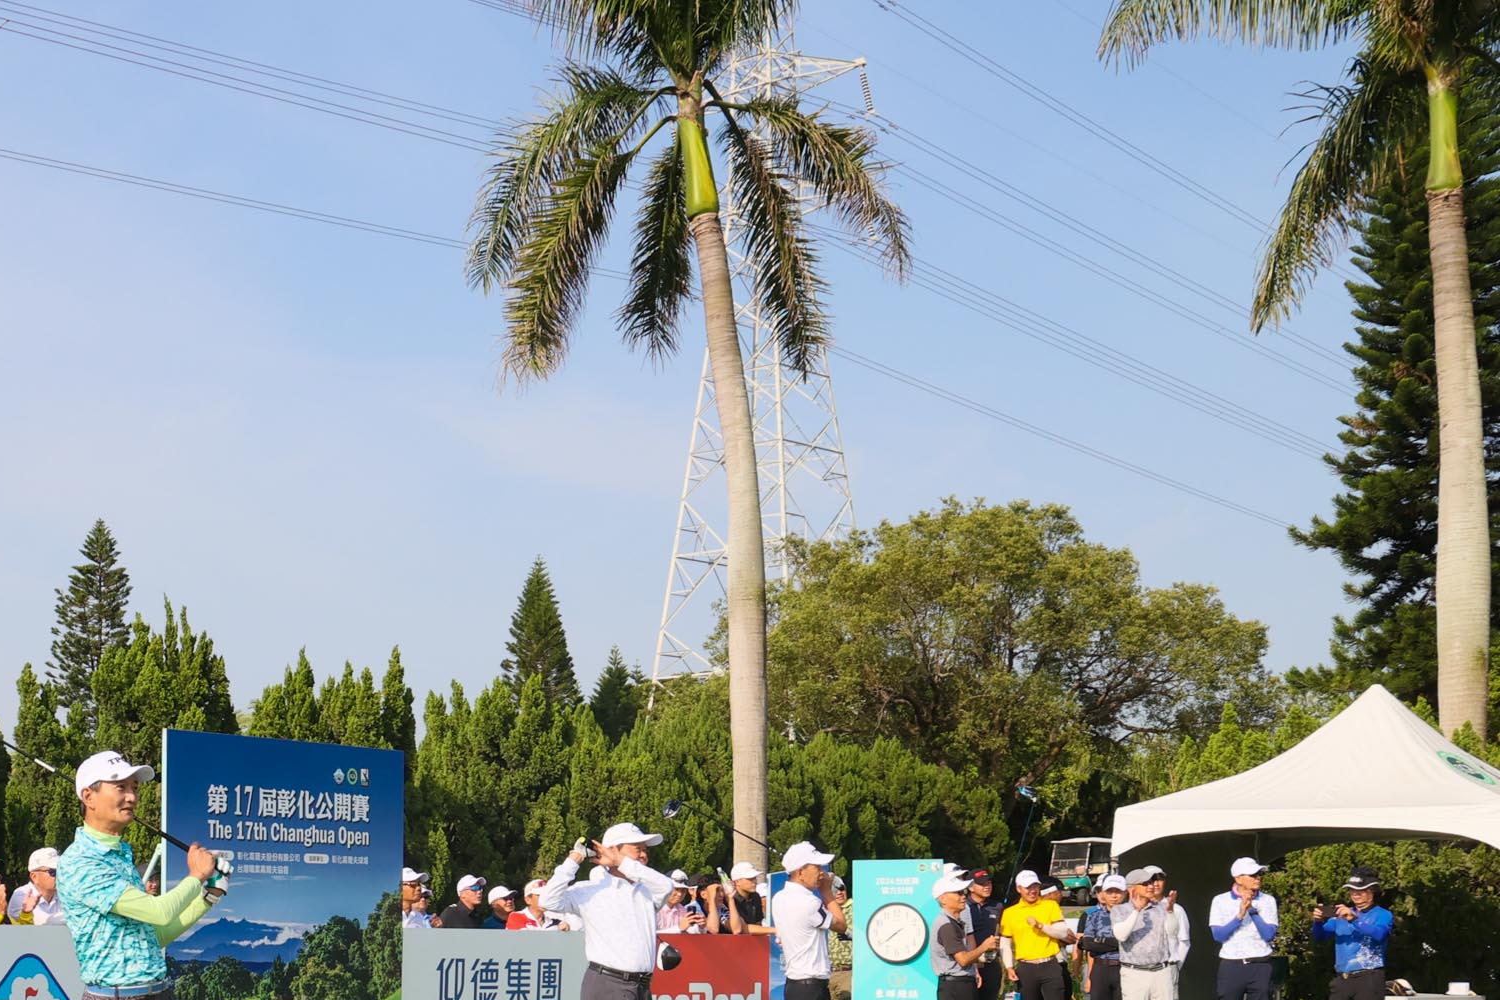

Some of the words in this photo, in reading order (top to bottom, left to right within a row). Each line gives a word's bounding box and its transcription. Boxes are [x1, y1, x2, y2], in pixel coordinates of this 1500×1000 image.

[208, 819, 233, 840] The
[236, 821, 267, 841] 17th
[271, 823, 335, 847] Changhua
[338, 826, 370, 848] Open
